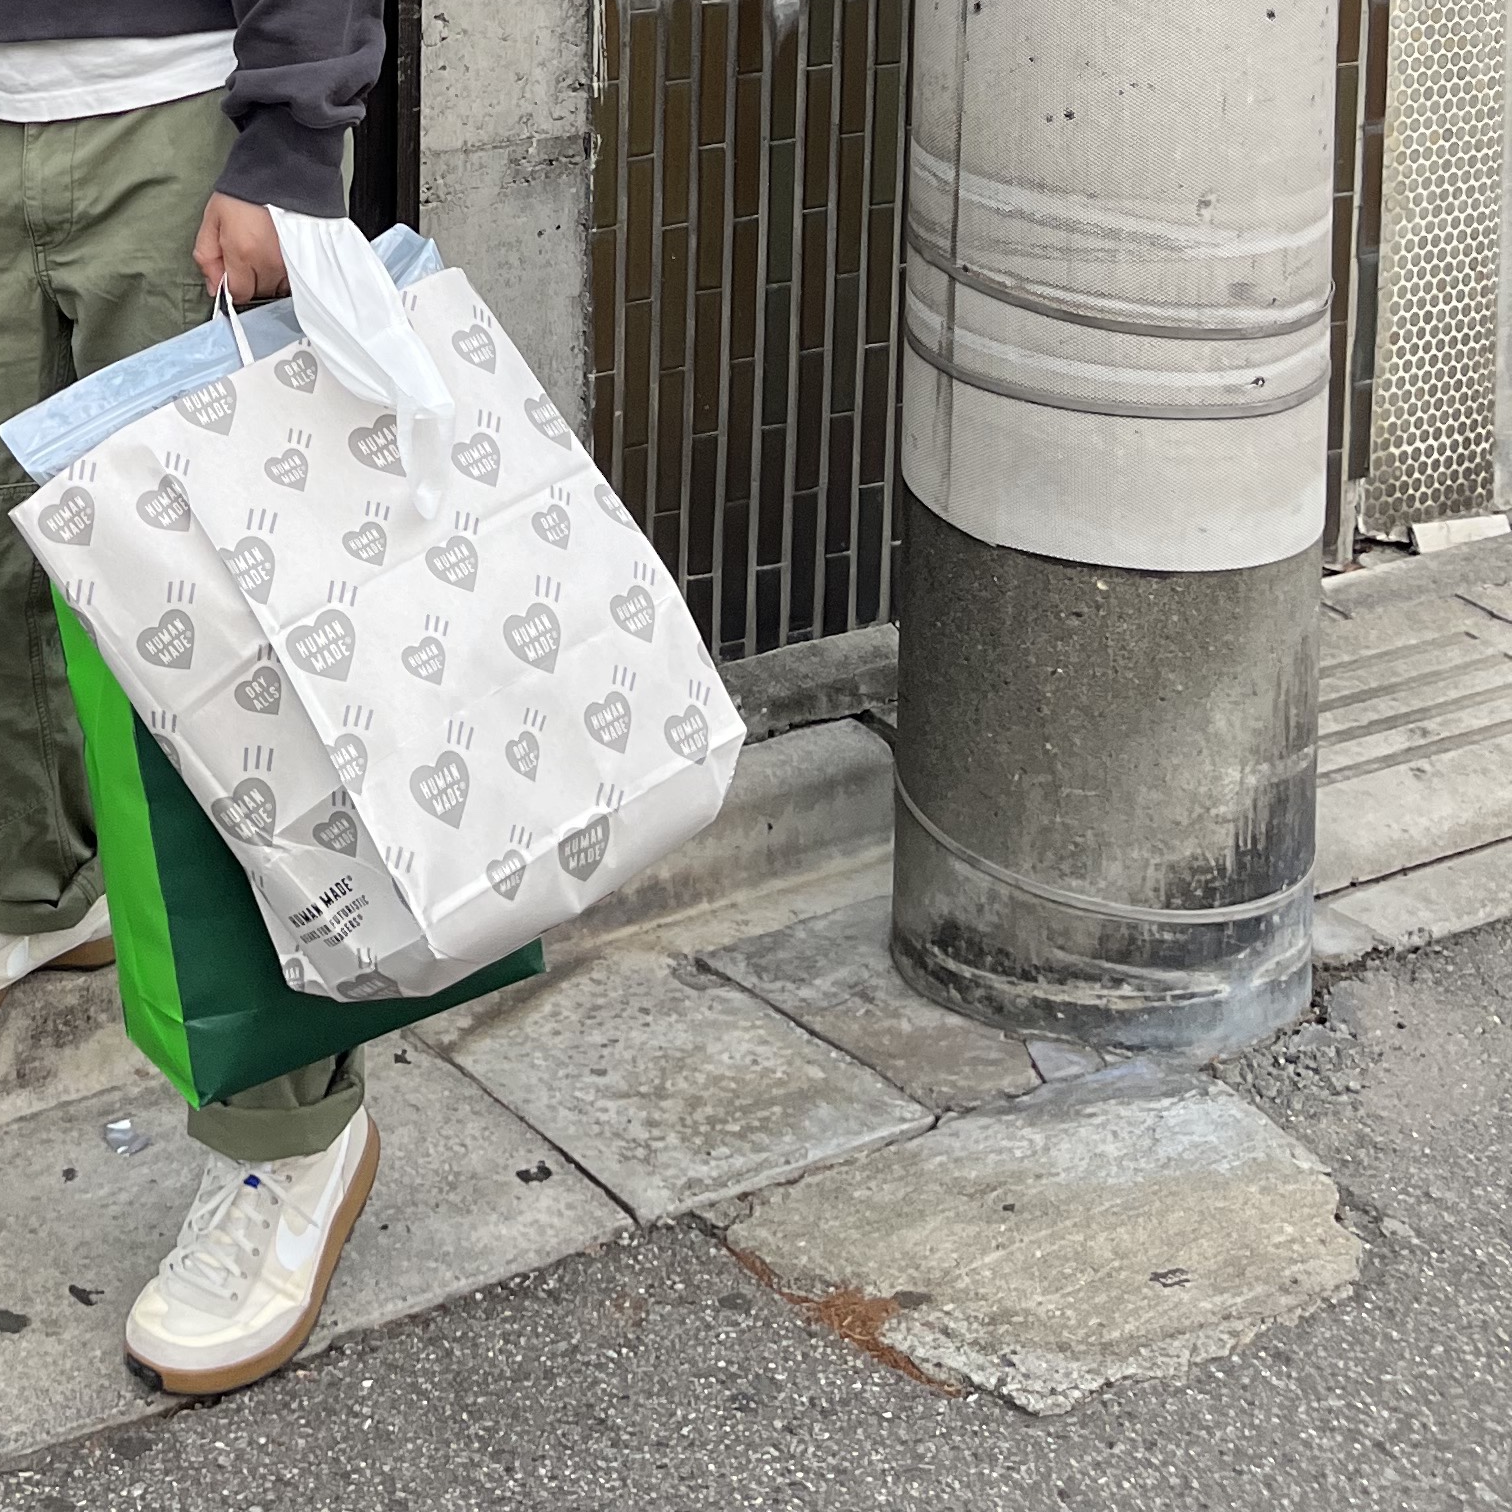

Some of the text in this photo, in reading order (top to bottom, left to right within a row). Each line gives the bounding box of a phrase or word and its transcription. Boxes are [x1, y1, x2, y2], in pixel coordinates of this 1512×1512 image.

[182, 381, 228, 413] HUMAN
[371, 442, 400, 469] MAD
[457, 440, 493, 466] HUMAN
[46, 496, 86, 532] HUMAN
[144, 481, 181, 518] HUMAN
[433, 543, 470, 571] HUMAN
[145, 618, 186, 655] HUMAN
[295, 620, 345, 658] HUMAN
[511, 614, 552, 646] HUMAN
[245, 675, 268, 699] DRY
[419, 763, 461, 799] HUMAN
